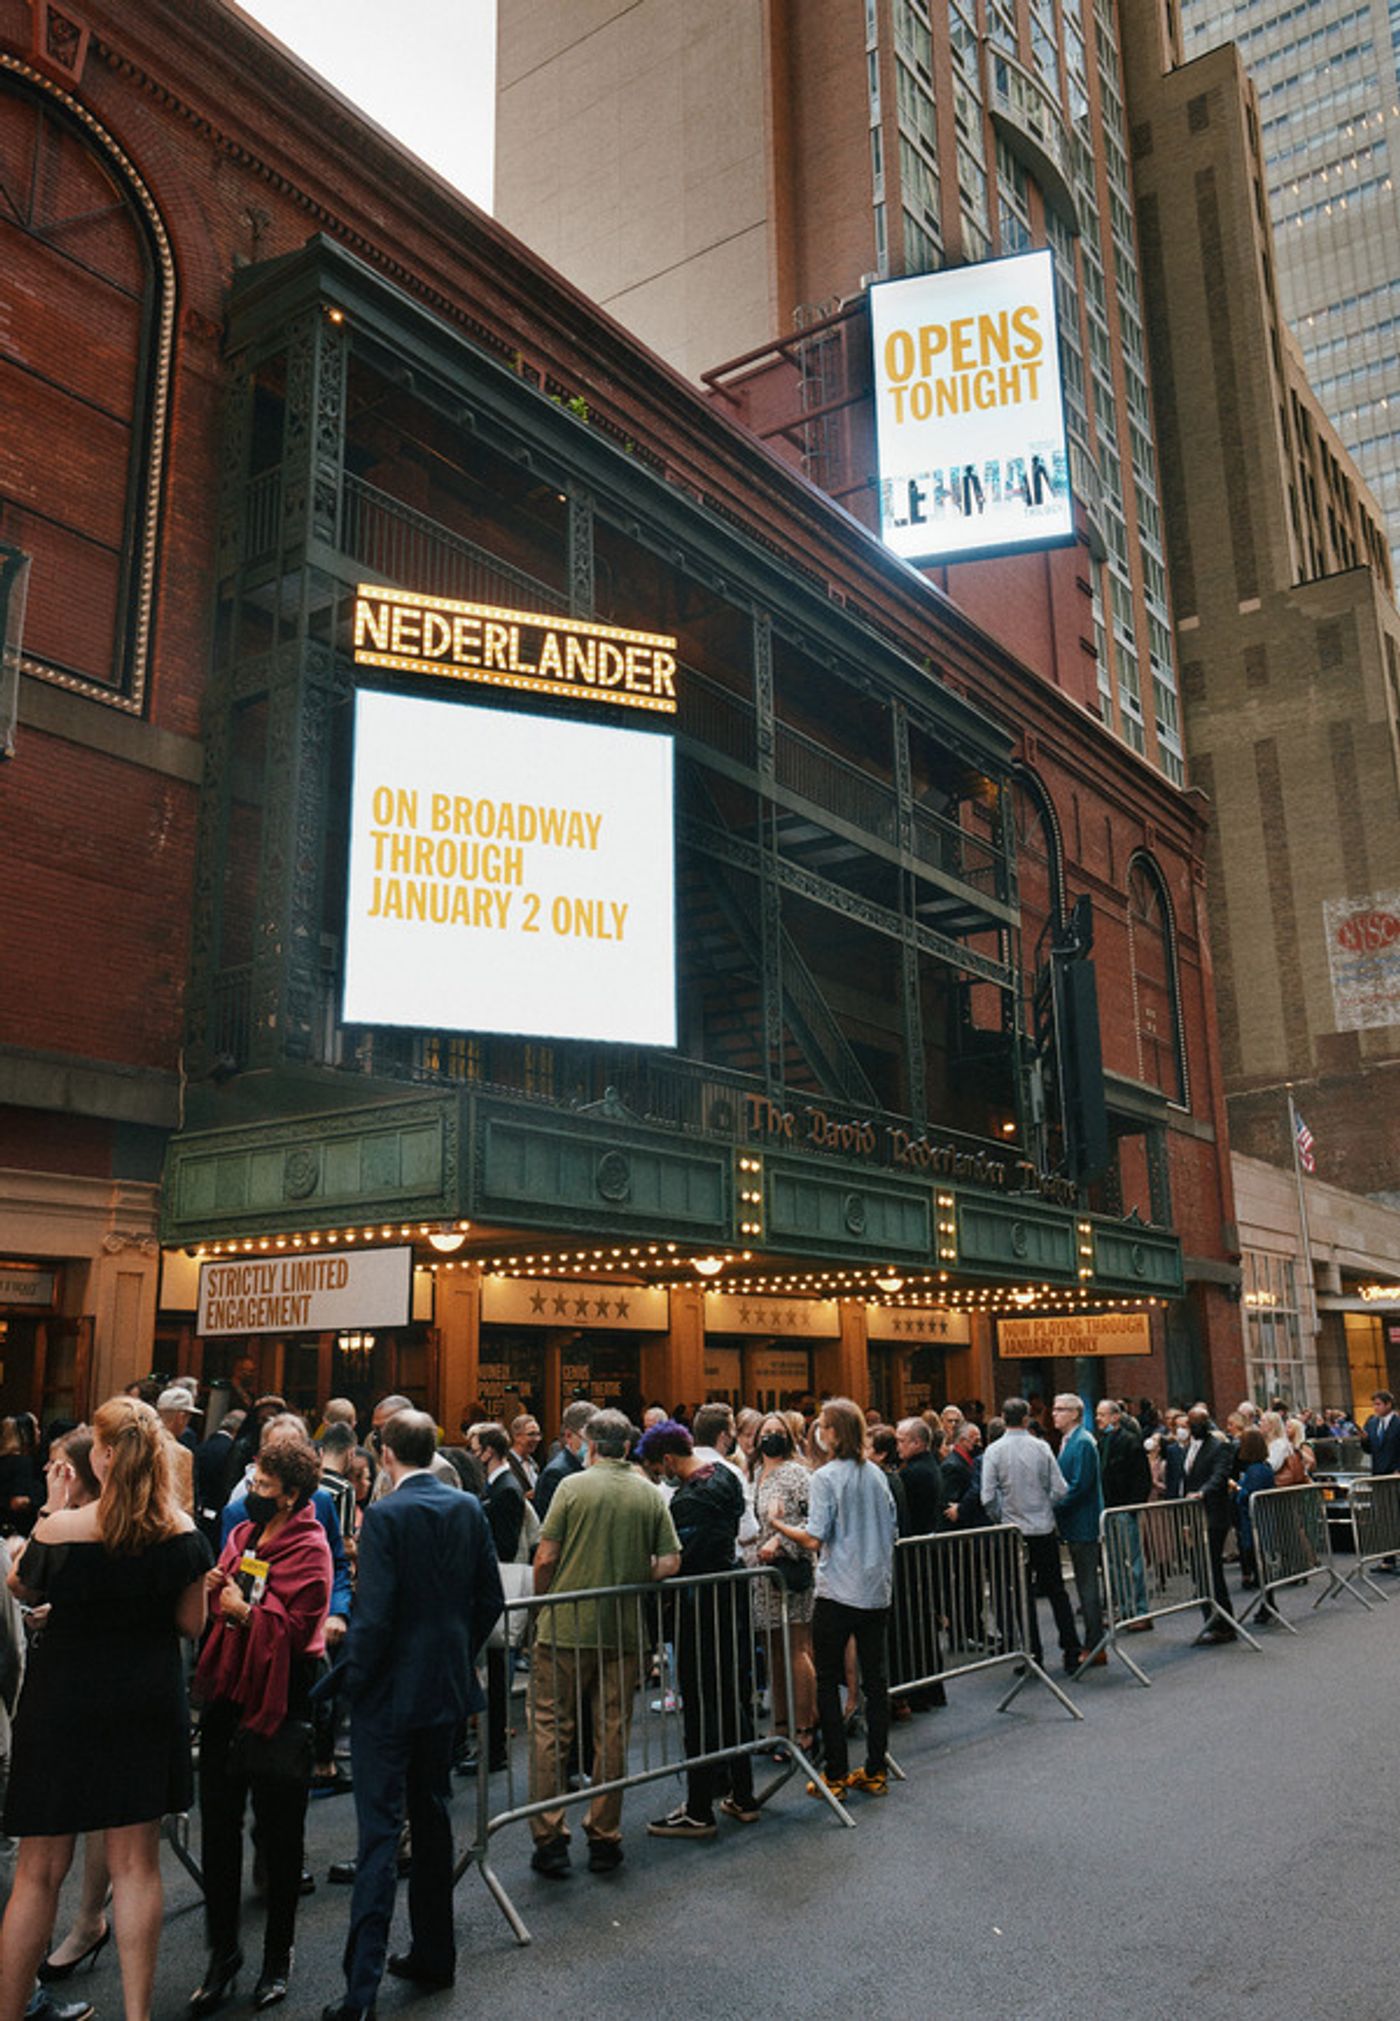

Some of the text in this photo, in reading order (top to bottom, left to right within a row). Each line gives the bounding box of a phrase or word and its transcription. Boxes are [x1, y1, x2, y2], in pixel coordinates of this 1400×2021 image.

[884, 305, 1044, 383] OPENS
[888, 361, 1043, 424] TONIGHT
[881, 450, 1068, 529] LEHMAN
[354, 600, 677, 696] NEDERLANDER
[372, 785, 602, 850] ON BROADWAY
[370, 831, 524, 886] THROUGH
[368, 877, 629, 941] JANUARY 2 ONLY
[745, 1093, 796, 1137] The
[803, 1106, 877, 1154] David
[207, 1258, 349, 1298] STRICTLY LIMITED
[205, 1295, 312, 1330] ENGAGEMENT
[1003, 1316, 1145, 1338] NOW PLAYING THROUGH
[1005, 1337, 1099, 1355] JANUARY 2 ONLY
